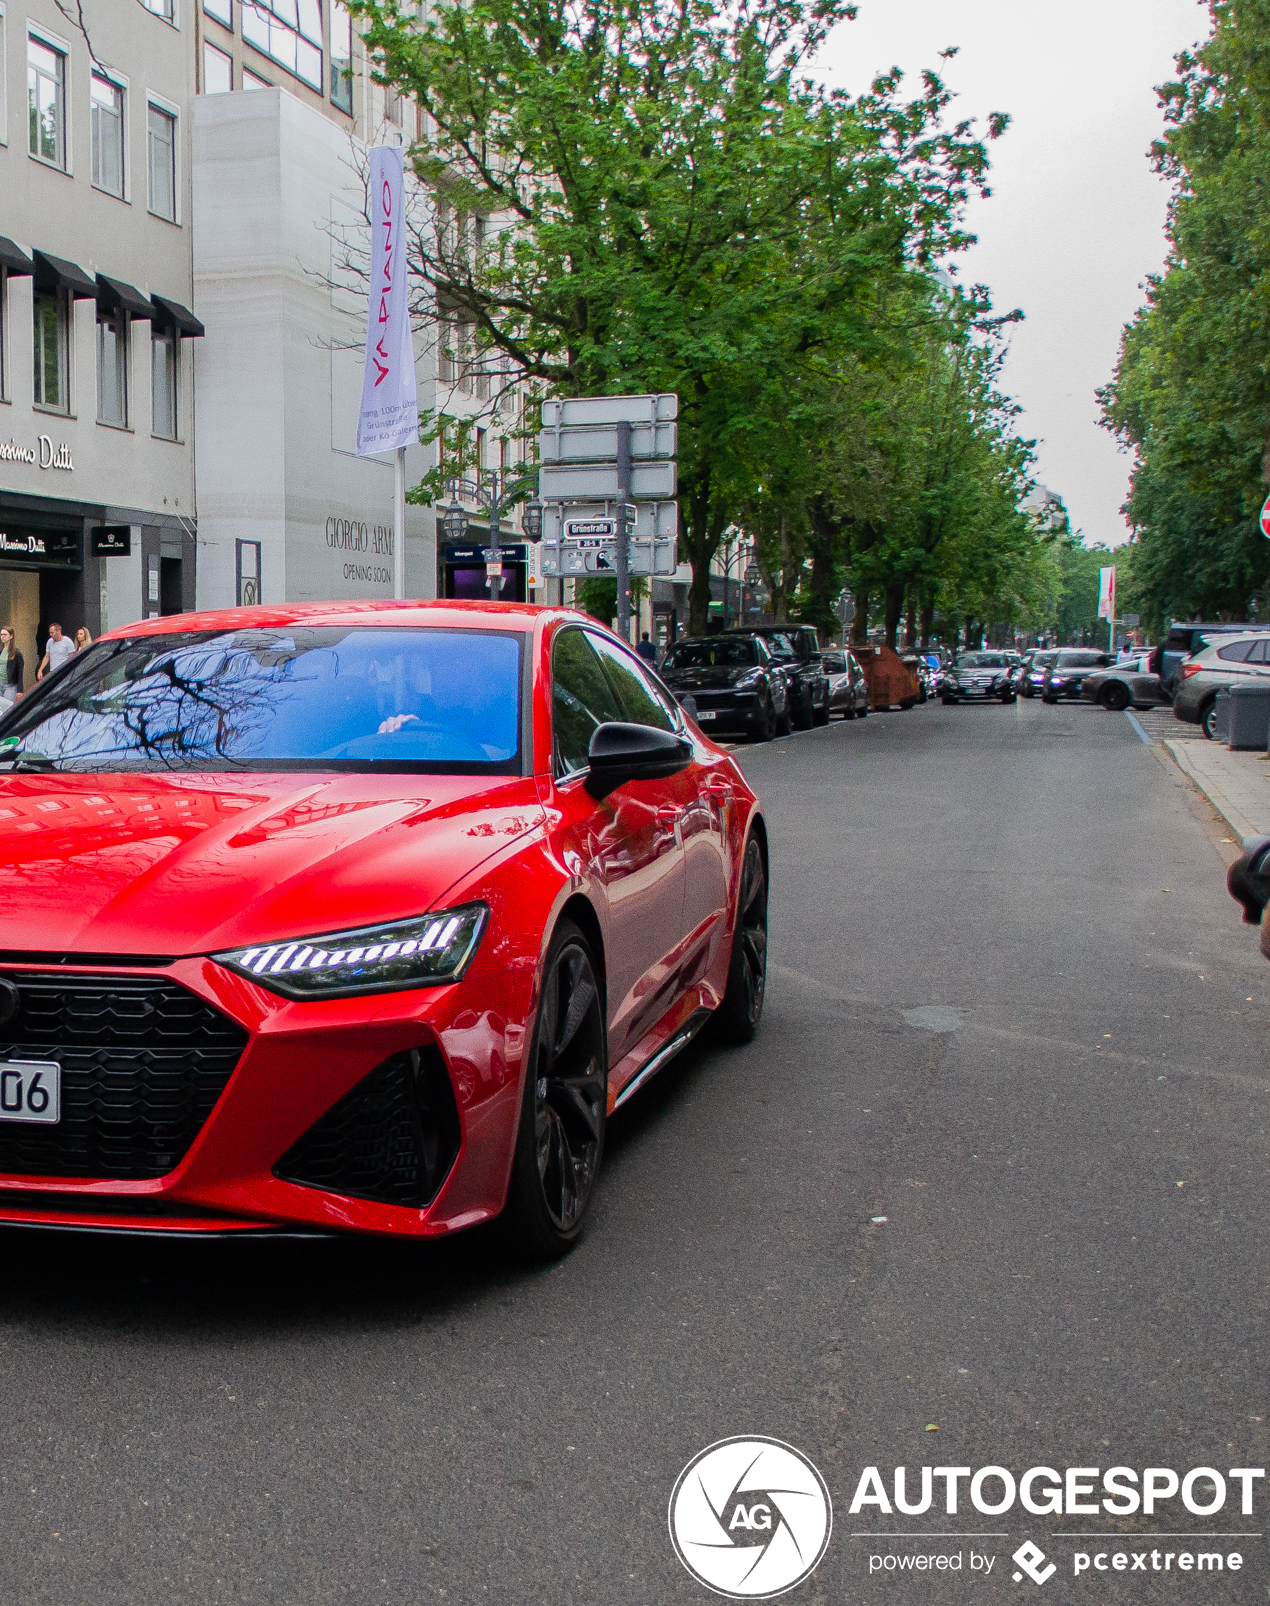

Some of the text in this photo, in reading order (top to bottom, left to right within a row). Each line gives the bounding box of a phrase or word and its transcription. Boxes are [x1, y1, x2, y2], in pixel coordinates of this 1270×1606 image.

[38, 434, 75, 470] Dutti
[325, 516, 368, 553] GIORGIO
[571, 523, 608, 534] Grünstraße
[28, 536, 46, 553] Dutti
[343, 563, 392, 583] OPENING SOON
